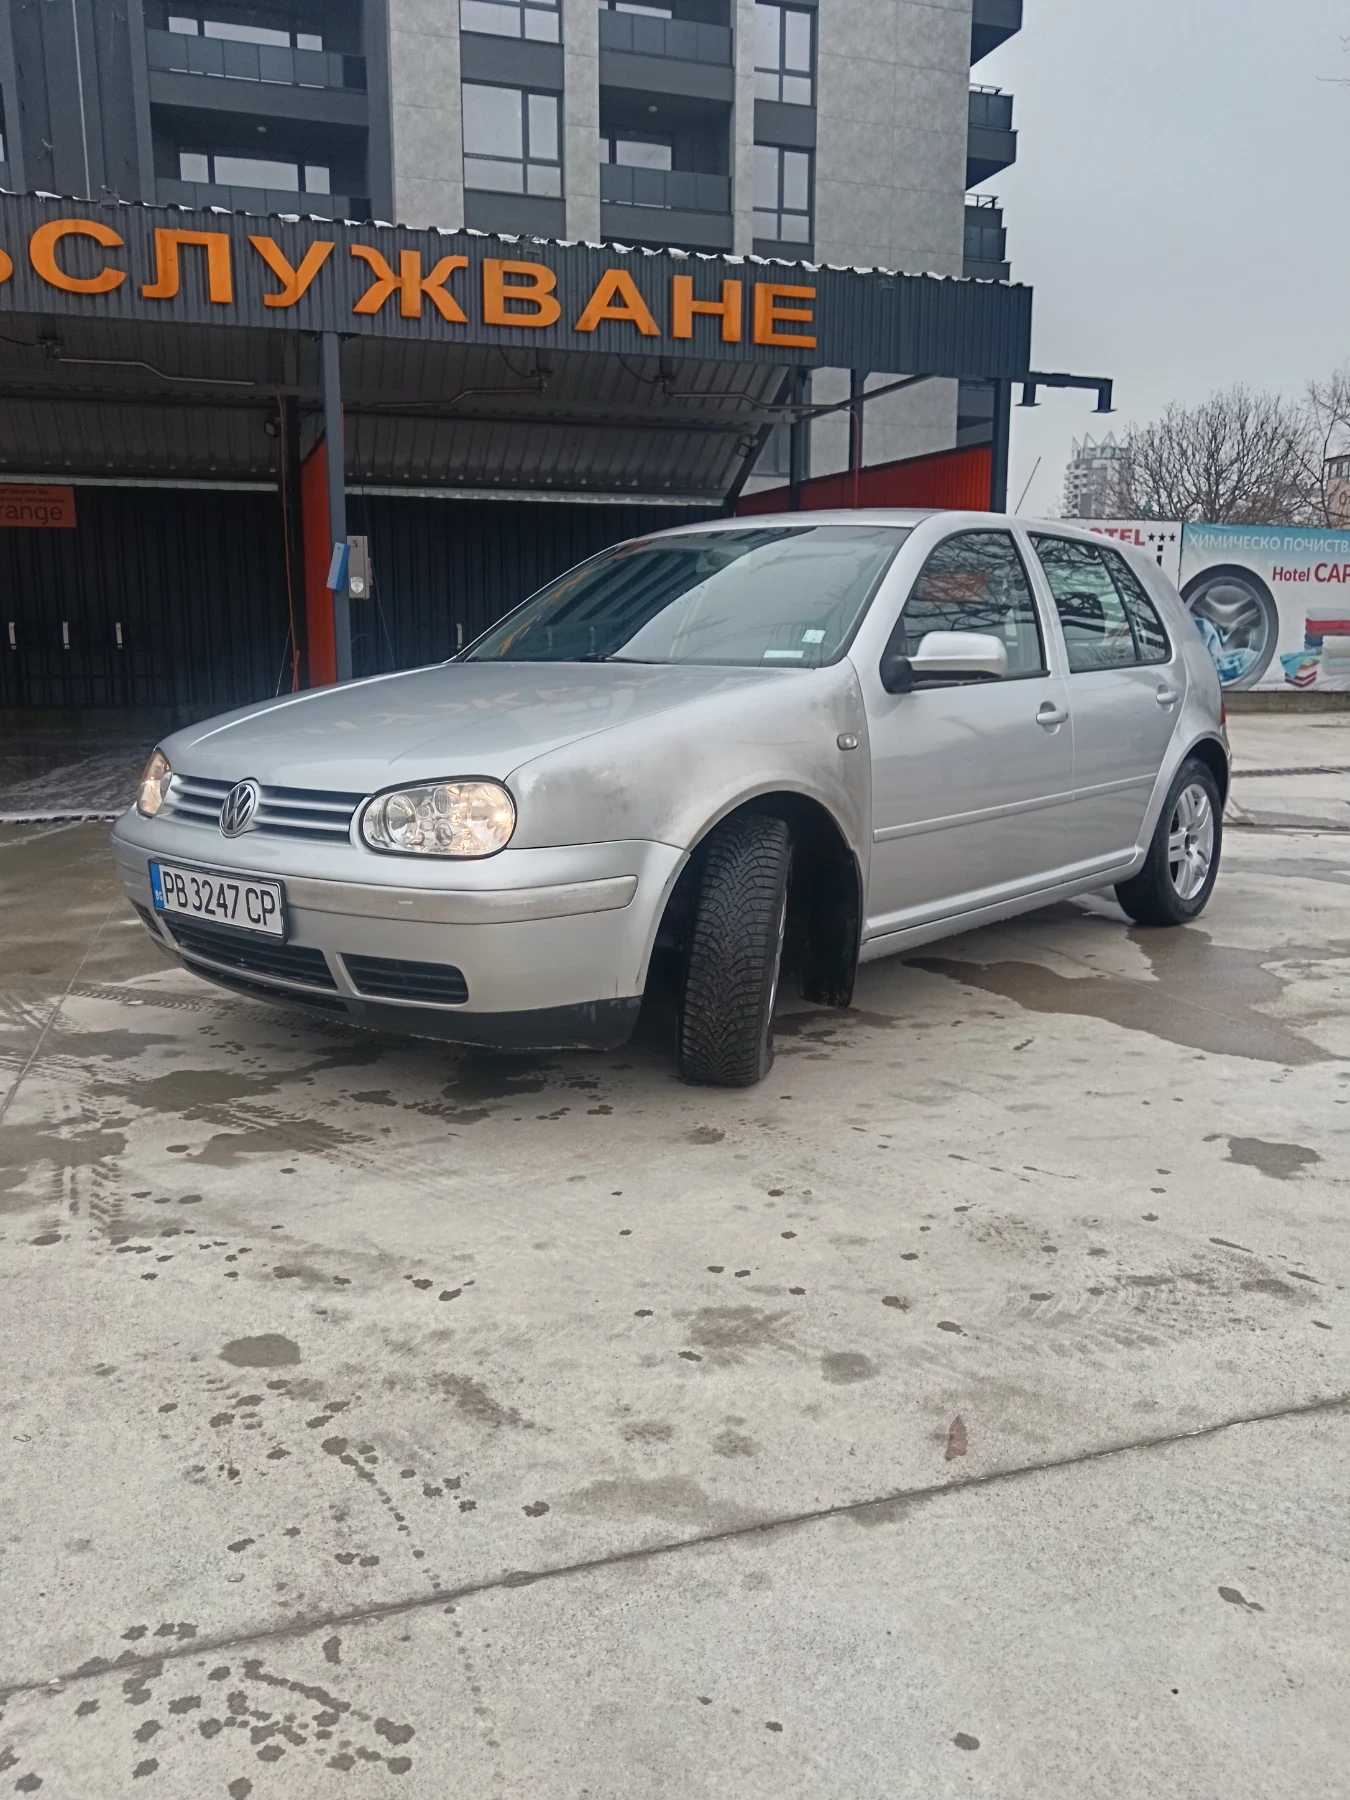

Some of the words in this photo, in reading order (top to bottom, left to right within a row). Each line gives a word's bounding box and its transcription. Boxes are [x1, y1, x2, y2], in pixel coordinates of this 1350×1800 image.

[0, 219, 818, 349] СЛУЖВАНЕ
[1080, 527, 1146, 547] TEL
[1188, 532, 1281, 551] ХИМИЧЕСКО
[1283, 536, 1350, 553] ПОЧИСТВ
[1272, 565, 1311, 583] Hotel
[162, 870, 189, 909] PB
[190, 877, 240, 920] 3247
[245, 887, 276, 926] CP
